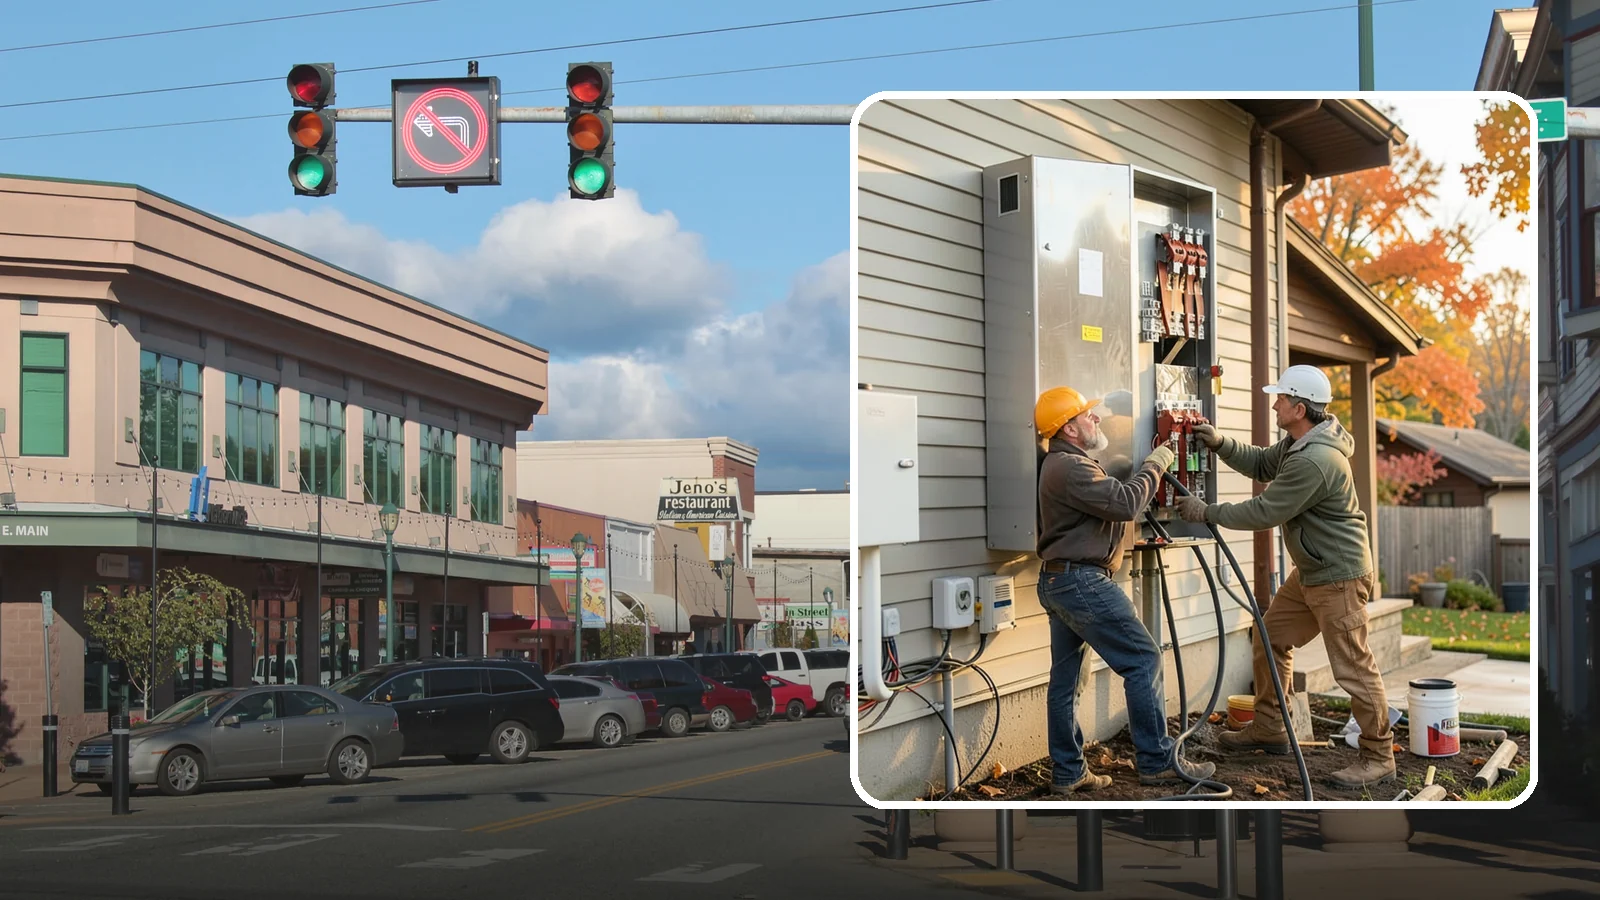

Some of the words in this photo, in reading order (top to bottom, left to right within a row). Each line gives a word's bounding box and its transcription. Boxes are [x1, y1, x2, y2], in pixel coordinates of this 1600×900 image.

[669, 480, 728, 495] Jeno's
[665, 496, 731, 509] restaurant
[658, 510, 681, 520] Italian
[686, 510, 715, 519] American
[715, 509, 738, 519] Cuisine
[2, 525, 13, 536] E.
[16, 525, 49, 536] MAIN
[797, 607, 829, 617] Street
[791, 619, 824, 627] lass
